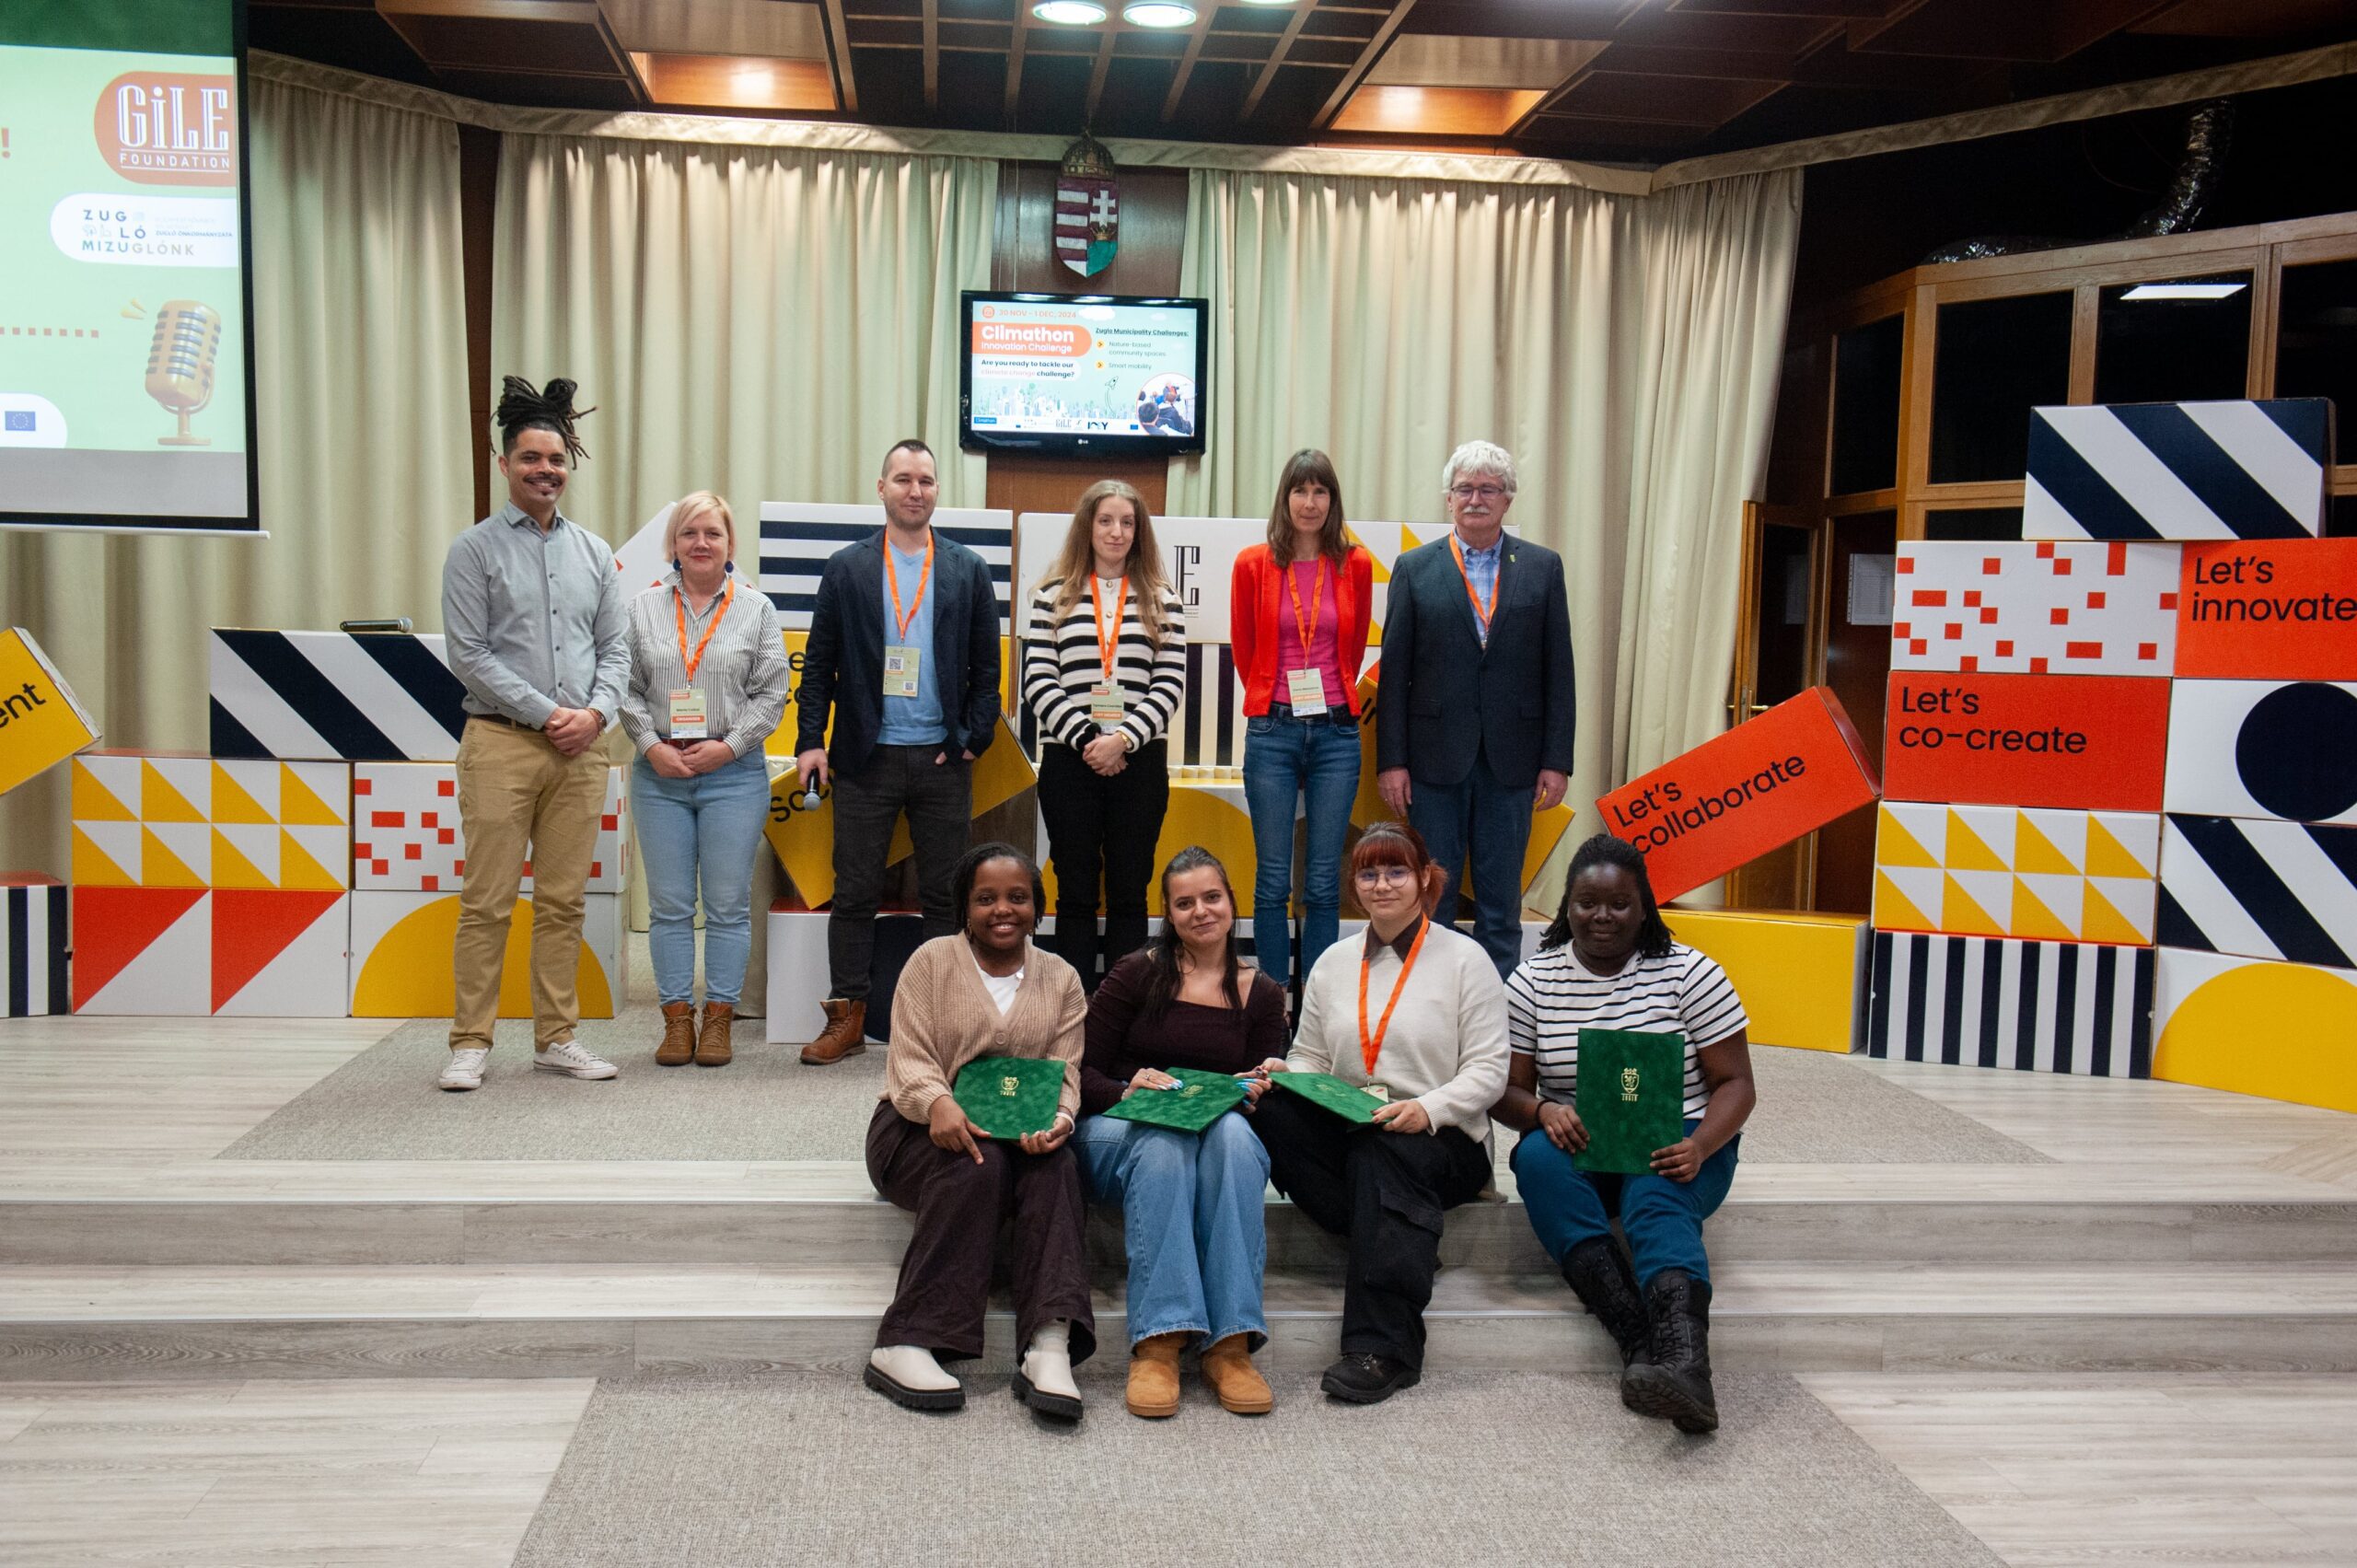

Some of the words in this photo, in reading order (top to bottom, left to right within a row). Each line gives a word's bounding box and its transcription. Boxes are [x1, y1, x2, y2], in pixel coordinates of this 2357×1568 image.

[117, 84, 229, 150] GiLE
[120, 153, 229, 168] FOUNDATION
[82, 240, 195, 256] MIZUGLÓNK
[981, 324, 1074, 343] Climathon
[1114, 328, 1152, 337] Municipality
[981, 342, 1027, 351] Innovation
[1028, 343, 1073, 354] Challenge
[1009, 360, 1029, 368] ready
[1128, 363, 1152, 371] mobility
[1037, 370, 1075, 378] challenge?
[2195, 556, 2274, 584] Let's
[2192, 592, 2357, 621] innovate
[1901, 687, 1980, 714] Let's
[1899, 726, 2087, 753] co-create
[1612, 782, 1683, 828] Let's
[1631, 756, 1806, 855] collaborate
